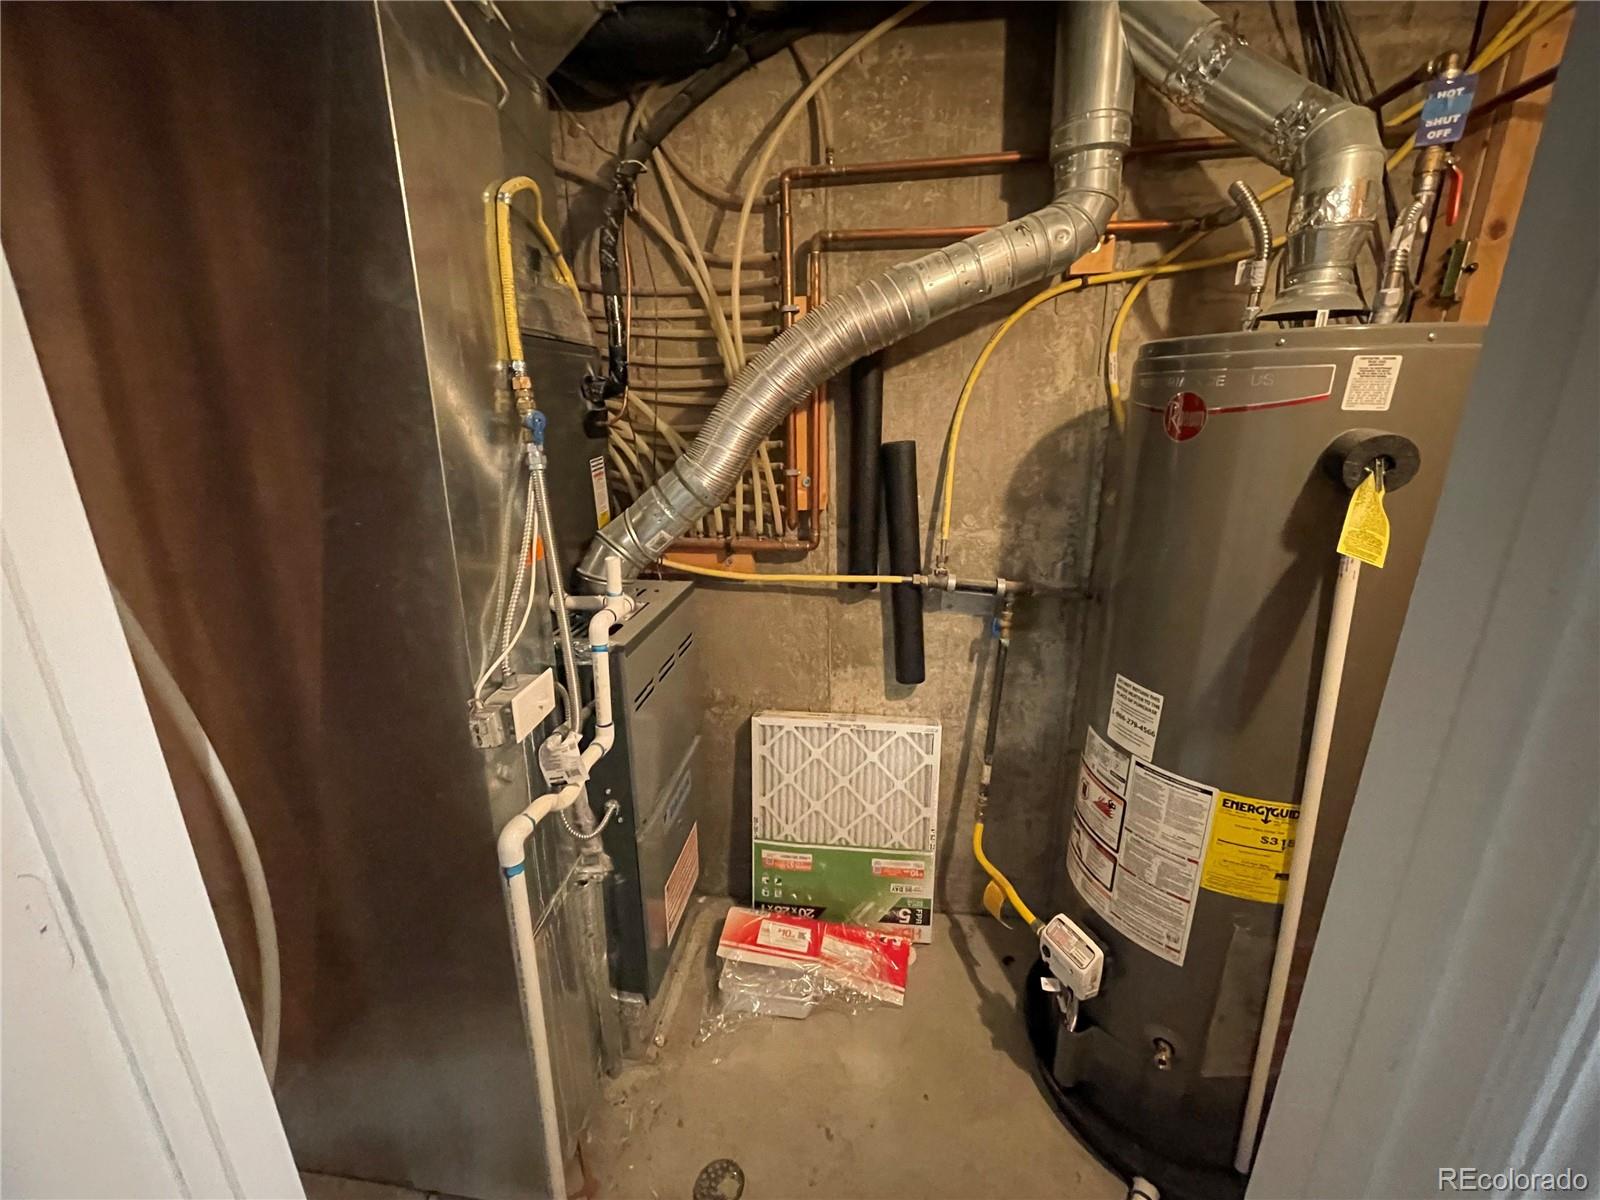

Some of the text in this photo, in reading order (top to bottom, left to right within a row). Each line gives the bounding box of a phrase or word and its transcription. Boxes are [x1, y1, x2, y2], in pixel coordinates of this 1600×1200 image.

[1436, 86, 1466, 99] HOT
[1424, 114, 1462, 128] SHUT
[1426, 128, 1452, 140] OFF
[1222, 798, 1301, 824] ENERGYGUID
